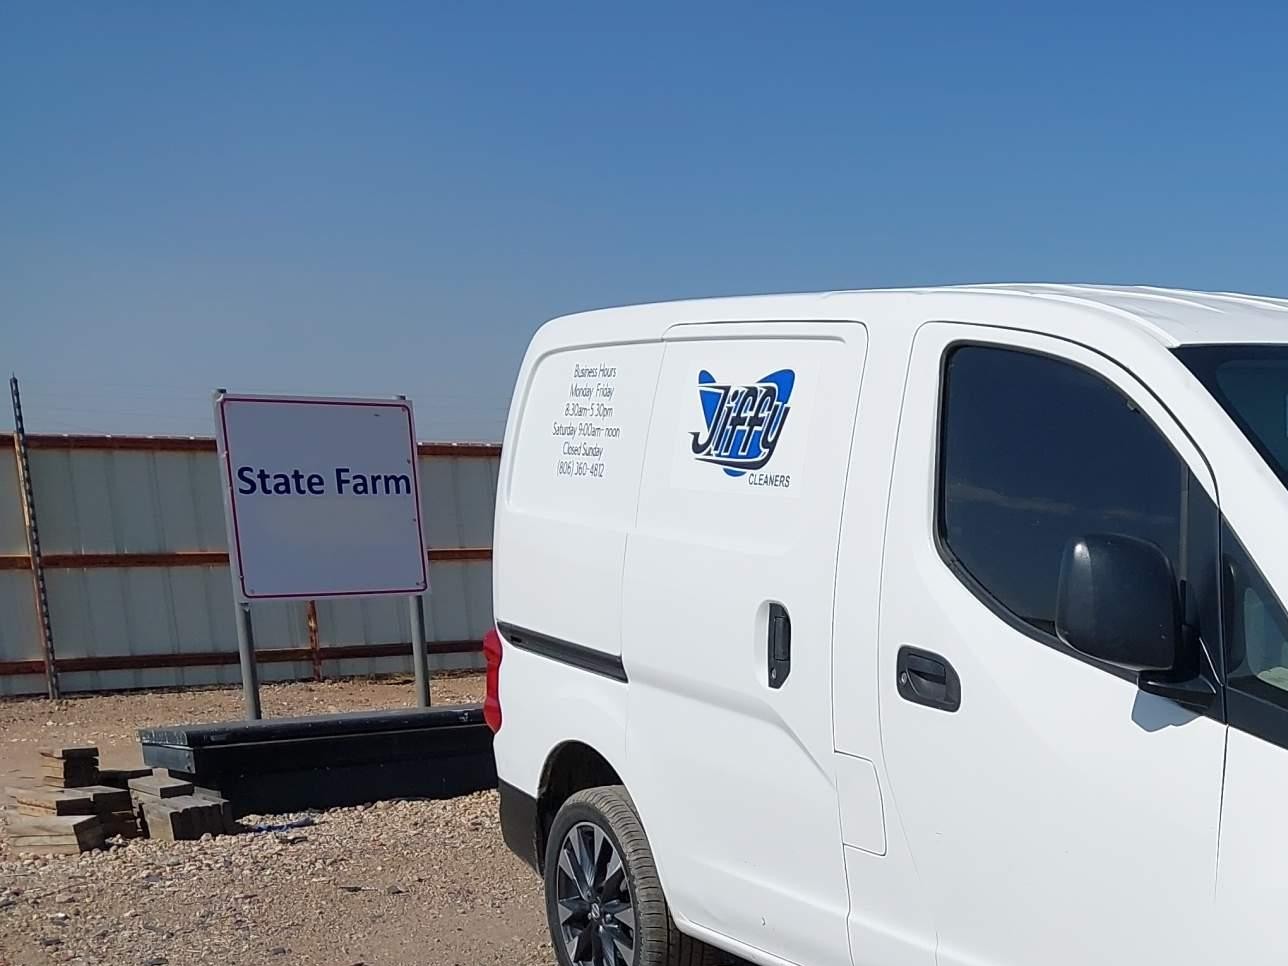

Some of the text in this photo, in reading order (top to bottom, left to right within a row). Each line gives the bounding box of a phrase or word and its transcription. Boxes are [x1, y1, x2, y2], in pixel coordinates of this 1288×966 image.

[574, 361, 617, 378] Business Hours
[569, 382, 615, 401] Monday Friday
[552, 421, 577, 440] Saturday
[688, 384, 790, 471] Jiffy
[562, 441, 604, 461] Closed Sunday
[557, 459, 605, 478] (806) 360-4812
[237, 466, 411, 495] State Farm
[748, 473, 790, 488] CLEANERS
